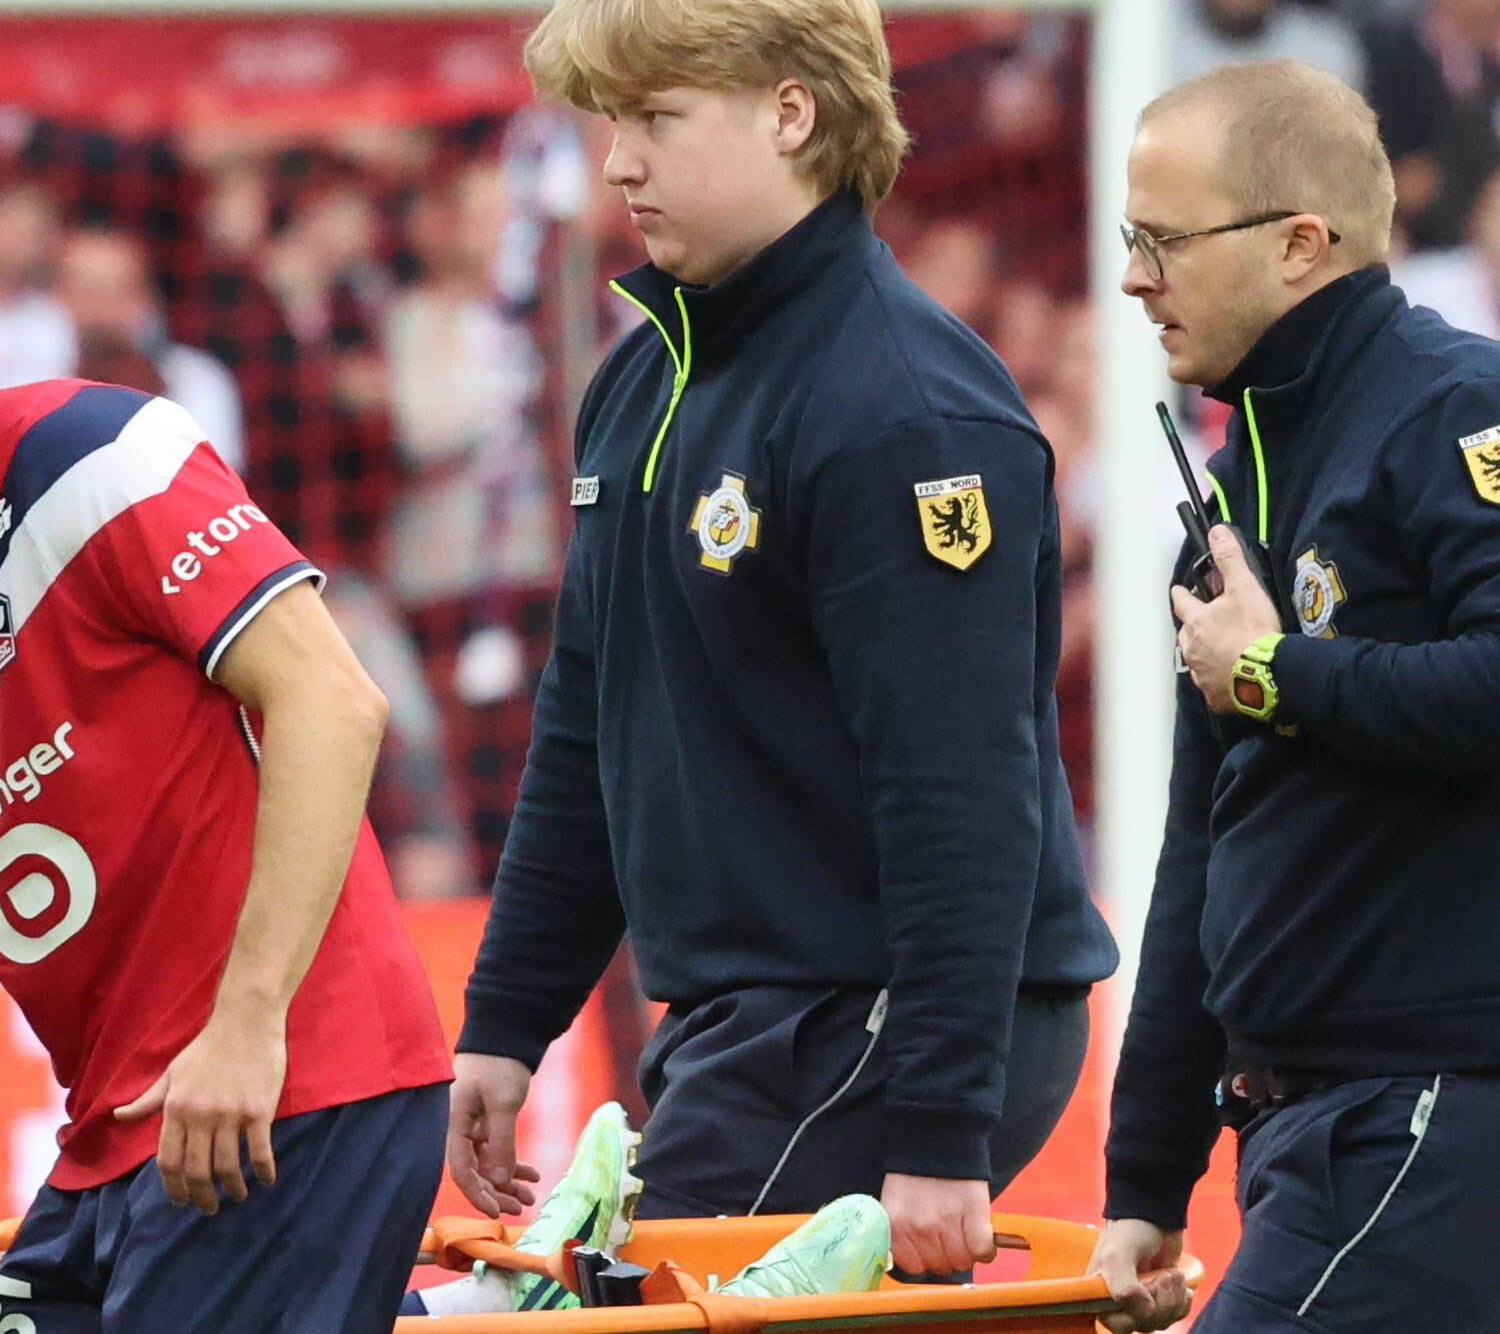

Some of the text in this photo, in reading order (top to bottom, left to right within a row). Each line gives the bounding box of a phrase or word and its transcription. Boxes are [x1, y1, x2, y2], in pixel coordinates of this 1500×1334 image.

[1463, 432, 1490, 446] FFSS
[919, 478, 978, 495] FFSS NORD
[171, 504, 269, 581] etoro
